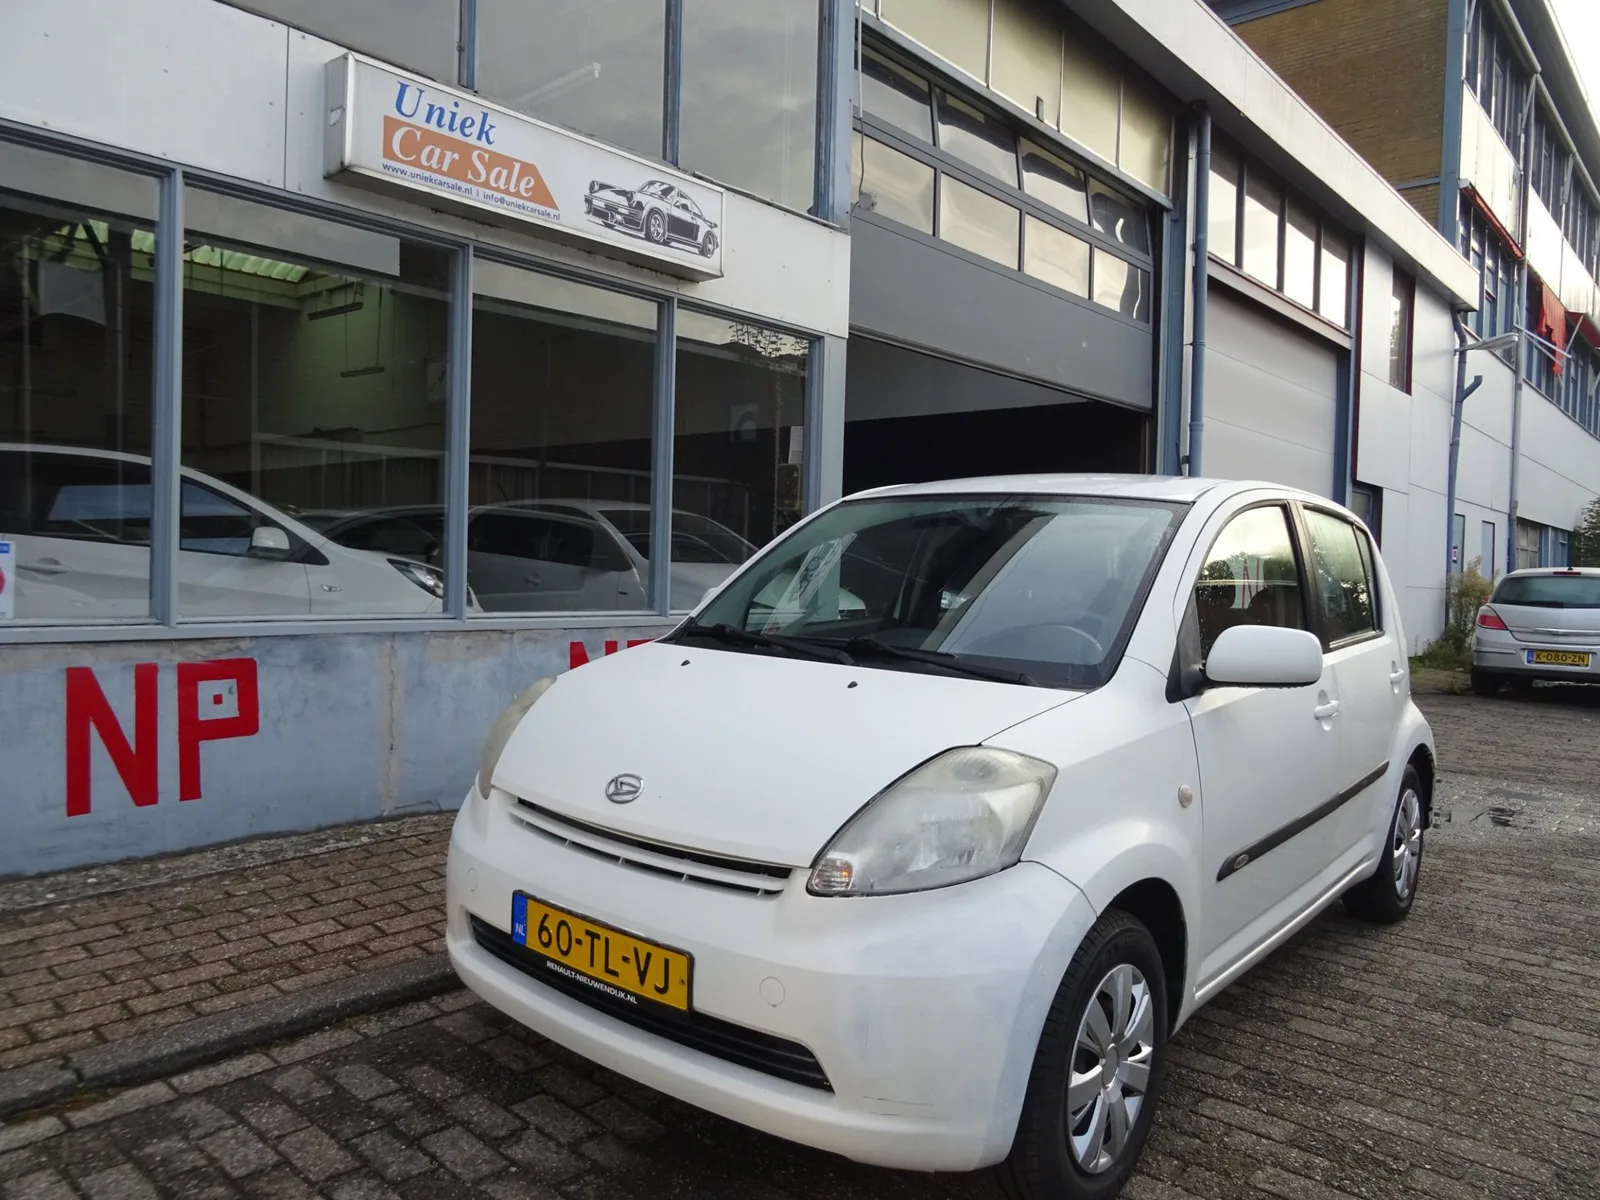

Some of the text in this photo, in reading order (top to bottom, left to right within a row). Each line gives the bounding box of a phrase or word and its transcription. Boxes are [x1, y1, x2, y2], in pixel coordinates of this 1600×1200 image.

[395, 80, 497, 145] Uniek
[382, 163, 473, 195] www.uniekcarsale.nl
[483, 191, 561, 221] info@uniekcarsale.nl
[391, 126, 535, 198] Car Sale
[1535, 652, 1585, 663] K-080-ZN
[66, 657, 259, 817] NP
[515, 923, 526, 937] NL
[537, 913, 670, 995] 60-TL-VJ
[546, 960, 638, 1005] RENAULT-NIEUWENDIJK.NL
